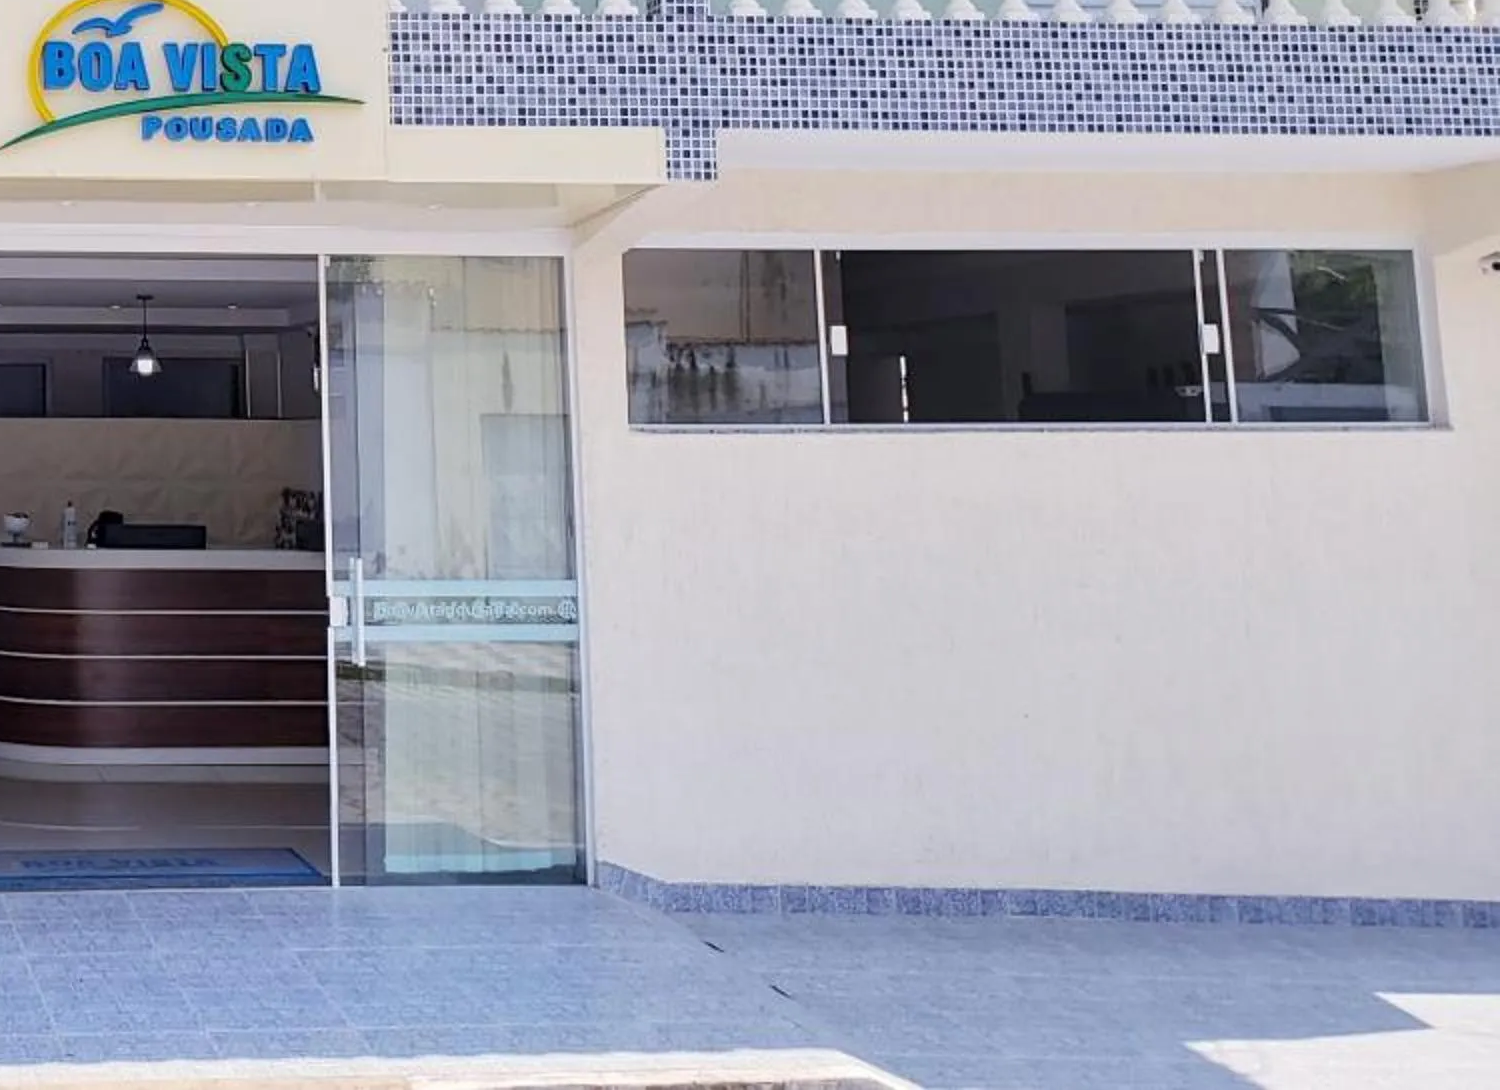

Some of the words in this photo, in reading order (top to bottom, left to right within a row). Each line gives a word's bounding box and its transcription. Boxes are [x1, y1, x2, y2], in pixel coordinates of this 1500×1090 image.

[42, 41, 151, 92] BOA
[163, 43, 323, 94] VISTA
[141, 116, 315, 143] POUSADA
